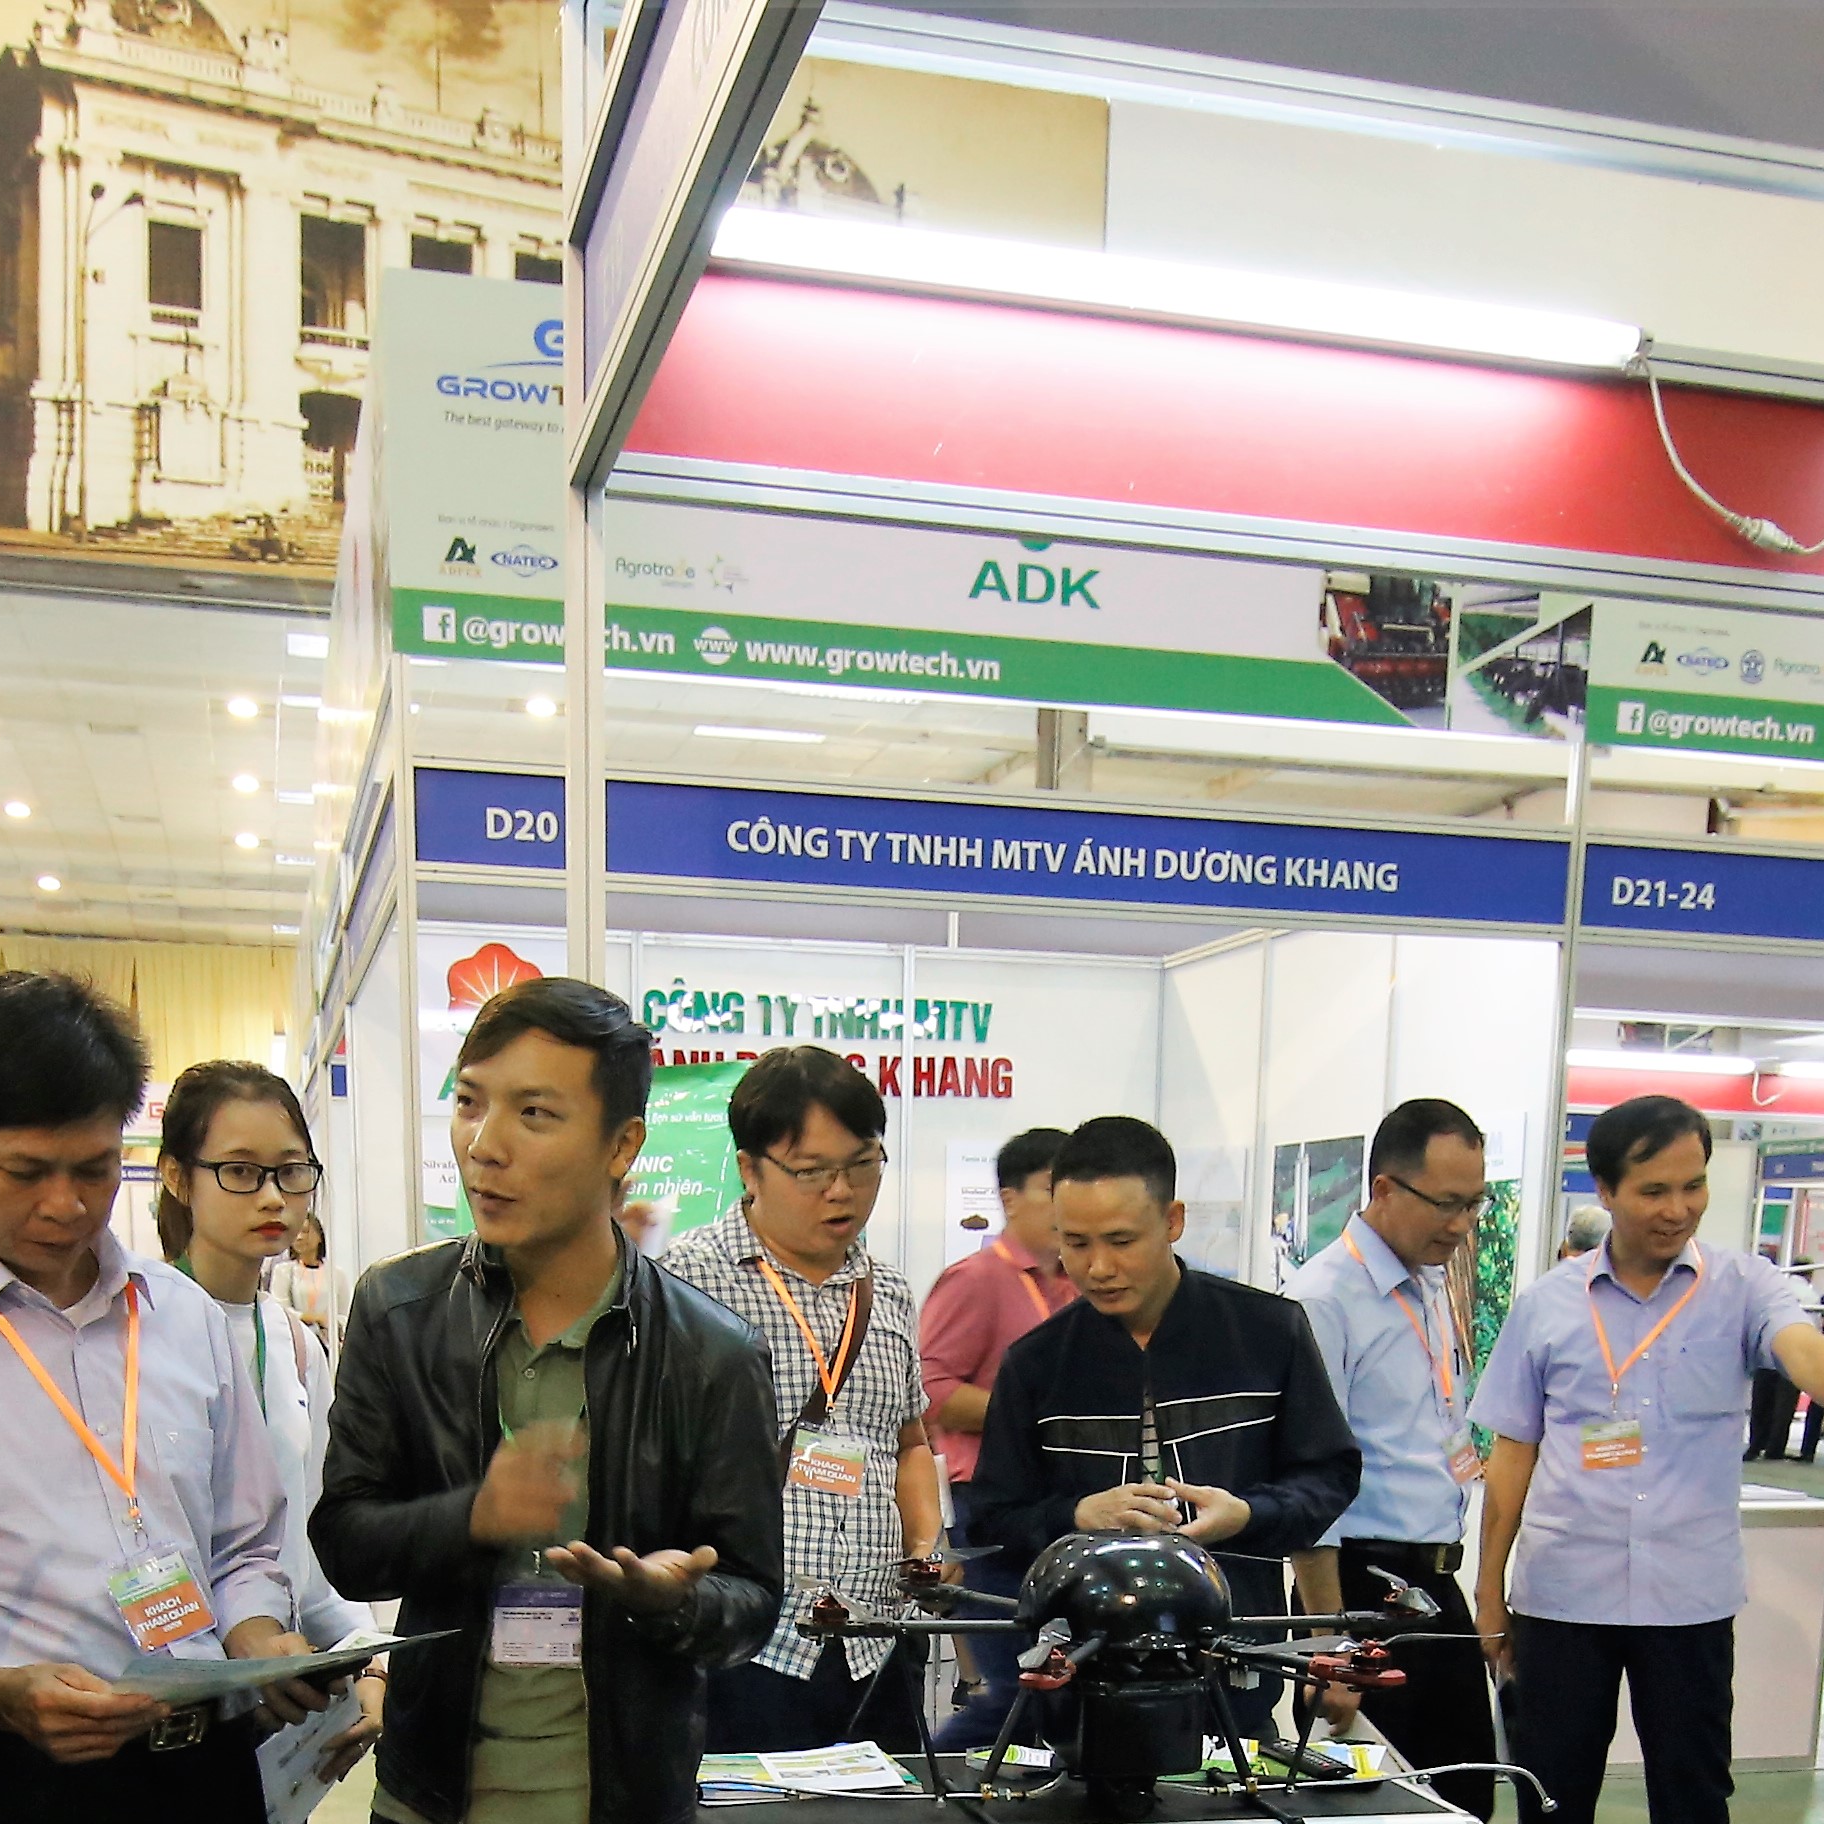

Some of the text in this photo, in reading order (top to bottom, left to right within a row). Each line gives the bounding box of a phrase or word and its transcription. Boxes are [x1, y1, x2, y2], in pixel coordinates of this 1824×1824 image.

[968, 560, 1101, 609] ADK
[745, 639, 1001, 680] www.growtech.vn
[1648, 710, 1815, 745] @growtech.vn
[484, 806, 560, 843] D20
[726, 815, 1400, 893] CÔNG TY TNHH MTV ÁNH DƯƠNG KHANG
[1611, 875, 1716, 911] D21-24
[643, 976, 745, 1034] CÔNG
[913, 998, 994, 1044] MTV
